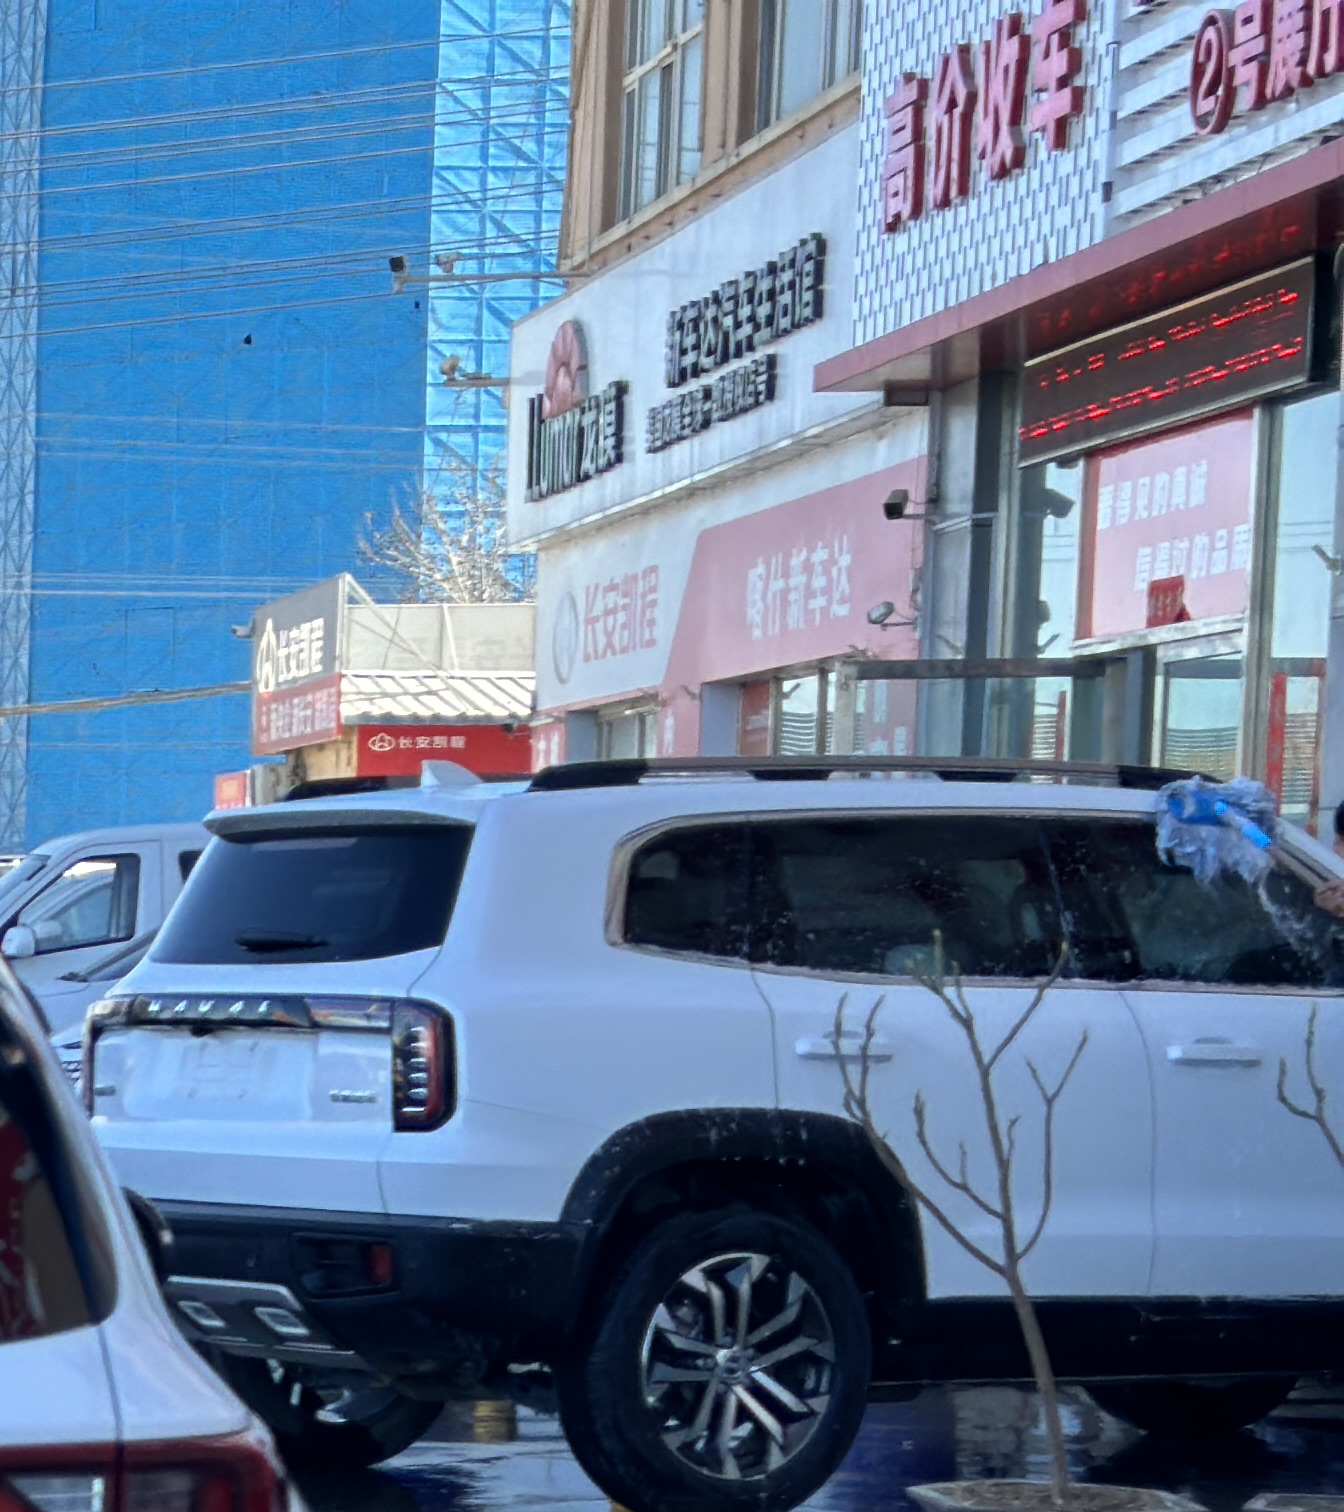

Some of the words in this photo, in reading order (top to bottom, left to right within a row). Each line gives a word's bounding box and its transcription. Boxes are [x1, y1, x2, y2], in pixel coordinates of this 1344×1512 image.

[882, 0, 1088, 234] 高价收车
[583, 565, 660, 664] 长安凯程
[745, 535, 853, 641] 喀什新车达
